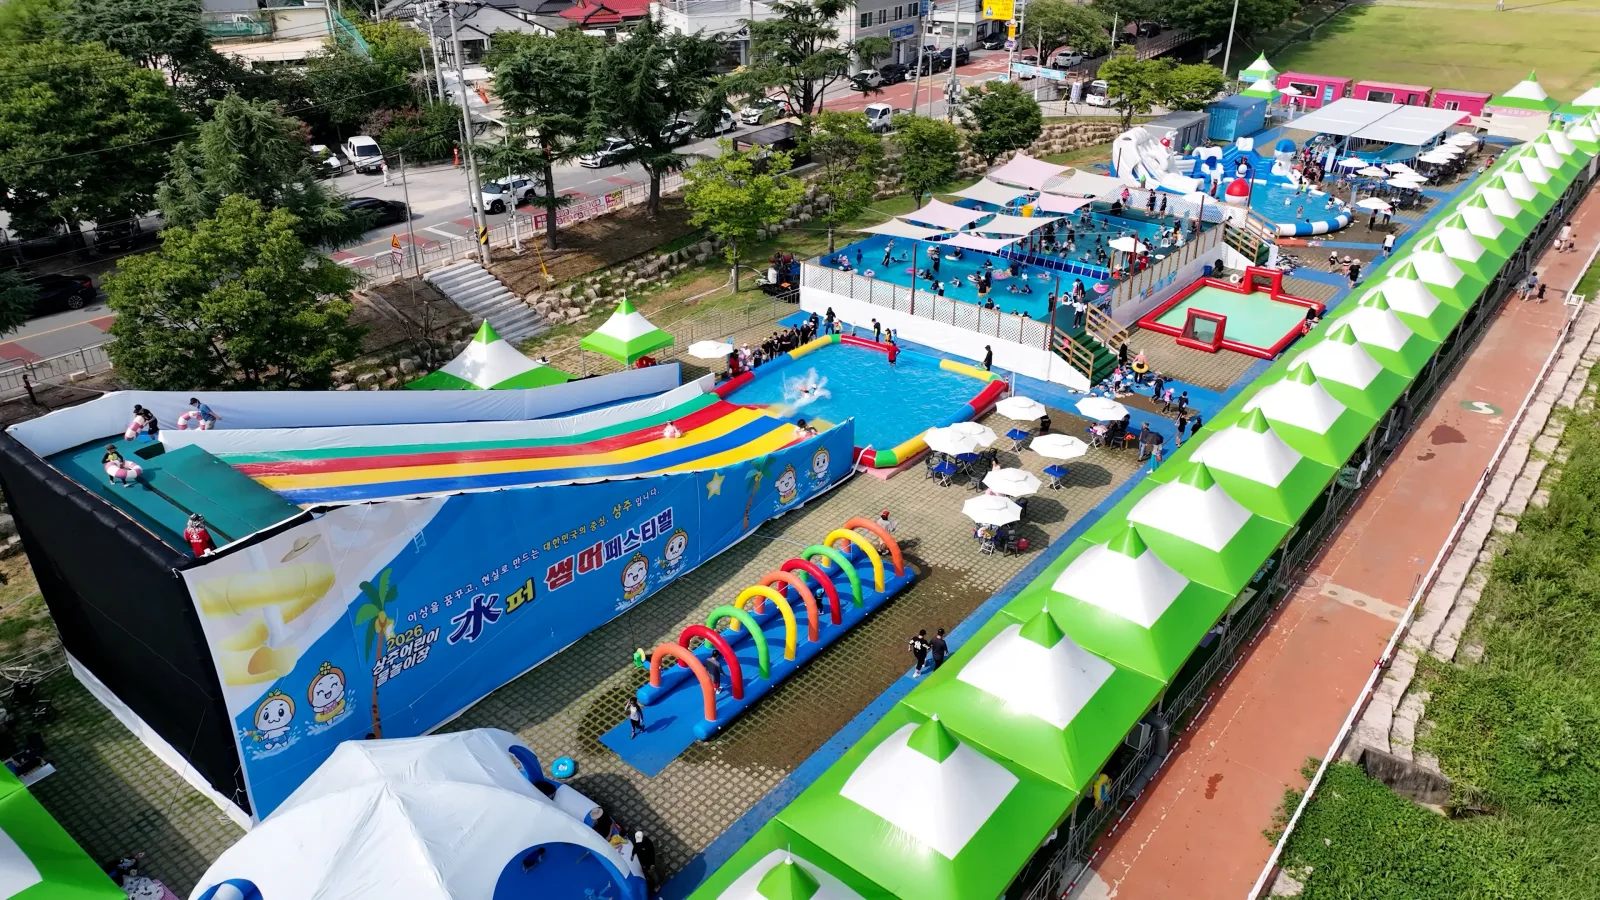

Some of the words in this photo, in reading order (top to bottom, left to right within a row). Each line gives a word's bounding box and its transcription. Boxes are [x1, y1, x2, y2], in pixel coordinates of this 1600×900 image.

[407, 601, 440, 622] 이상을
[444, 584, 478, 607] 꿈꾸고,
[481, 564, 510, 586] 현실로
[513, 549, 540, 569] 만드는
[543, 525, 587, 551] 대한민국의
[612, 499, 633, 519] 상주
[635, 487, 660, 507] 입니다.
[372, 627, 440, 676] 상주어린이
[386, 624, 423, 652] 2026
[376, 645, 431, 688] 물놀이장
